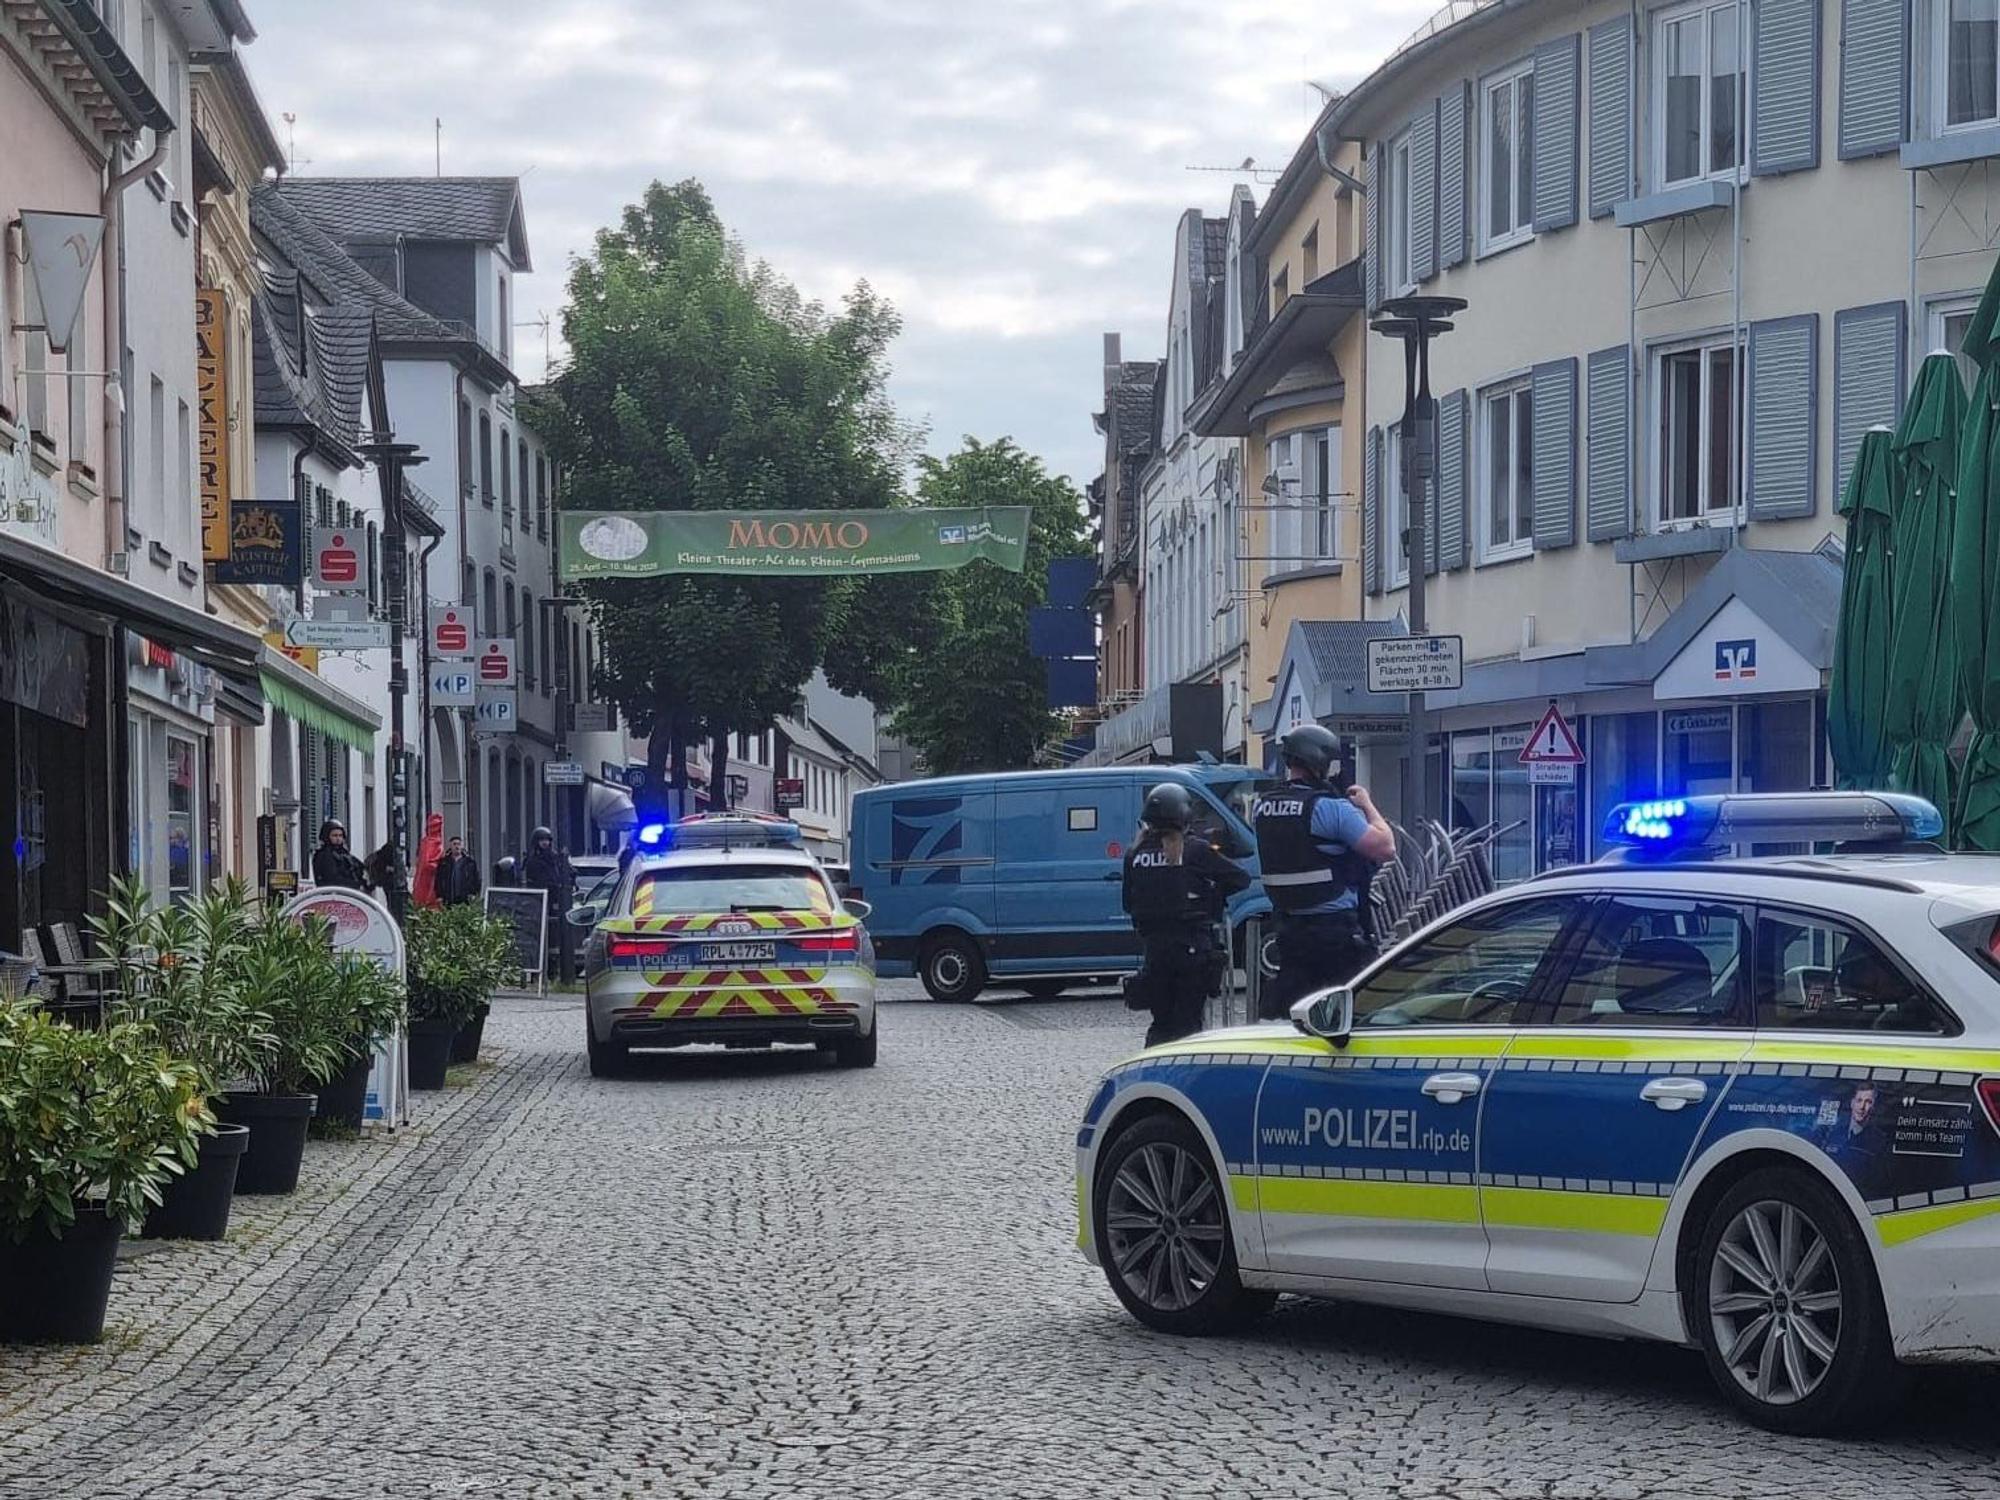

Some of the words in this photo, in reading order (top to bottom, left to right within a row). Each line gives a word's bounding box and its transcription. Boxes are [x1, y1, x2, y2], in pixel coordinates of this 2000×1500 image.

[726, 519, 868, 550] MOMO
[678, 552, 712, 565] Kleine
[717, 554, 784, 567] Theater-AG
[788, 555, 807, 567] des
[811, 552, 920, 568] Rhein-Gymnasiums
[1380, 643, 1413, 652] Parken
[1415, 642, 1429, 650] mit
[1440, 641, 1447, 650] in
[1375, 652, 1454, 667] gekennzeichneten
[1380, 665, 1414, 676] Flächen
[1417, 664, 1427, 674] 30
[1379, 677, 1420, 688] werktags
[1445, 675, 1452, 684] h
[1253, 800, 1304, 818] POLIZEI
[702, 943, 725, 960] RPL
[729, 945, 736, 957] 4
[744, 943, 775, 958] 7754
[642, 953, 690, 966] POLIZEI
[1897, 1115, 1917, 1127] Dein
[1918, 1117, 1949, 1129] Einsatz
[1261, 1107, 1470, 1156] www.POLIZEI.rlp.de
[1895, 1130, 1922, 1141] Komm
[1924, 1130, 1937, 1143] ins
